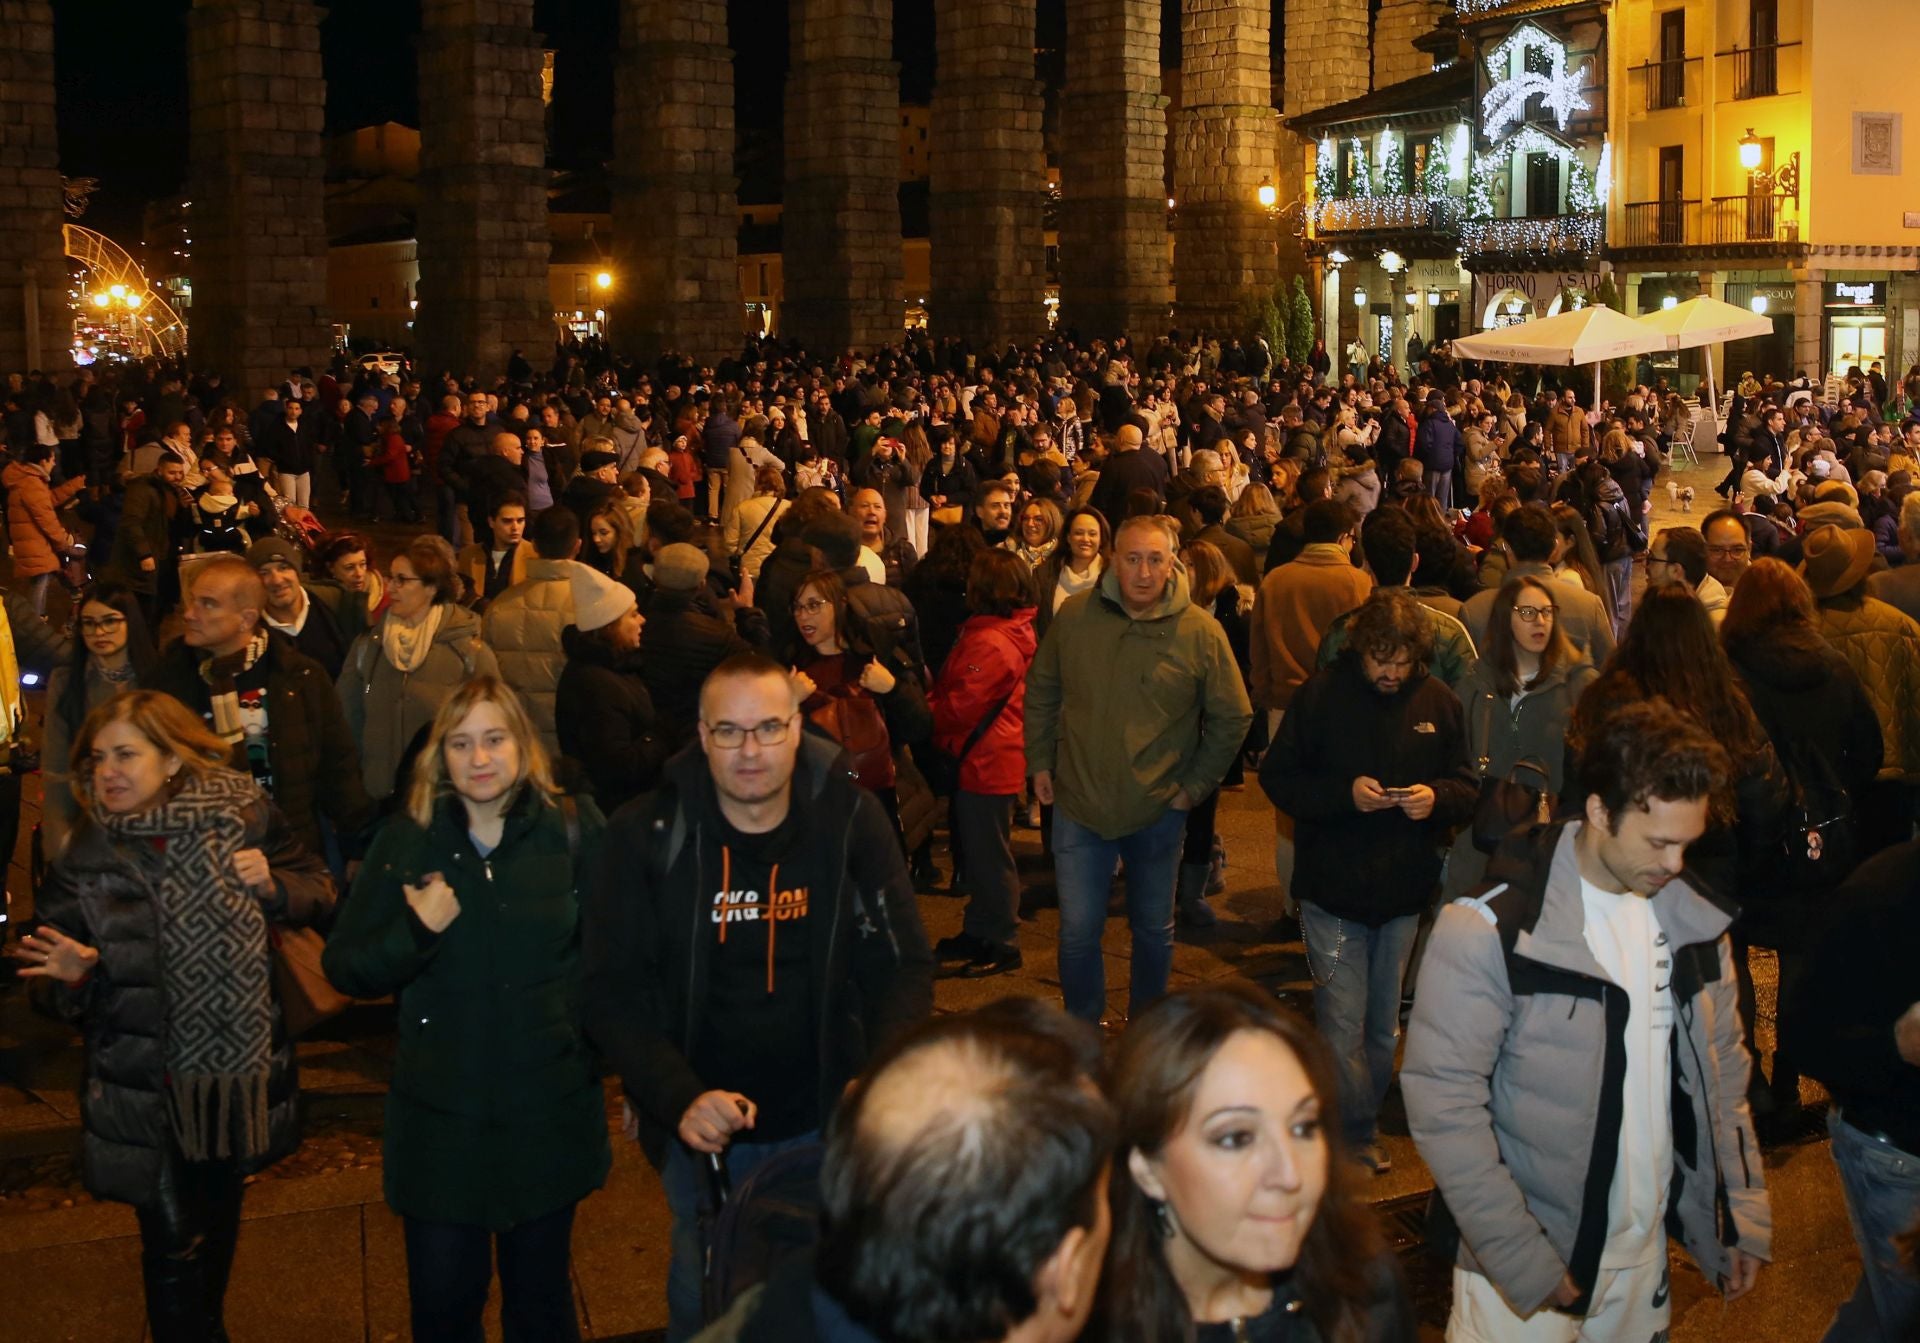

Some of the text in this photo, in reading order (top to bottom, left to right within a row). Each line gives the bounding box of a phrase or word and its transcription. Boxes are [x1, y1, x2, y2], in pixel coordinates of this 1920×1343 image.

[1485, 273, 1602, 310] HORNO DE ASAR
